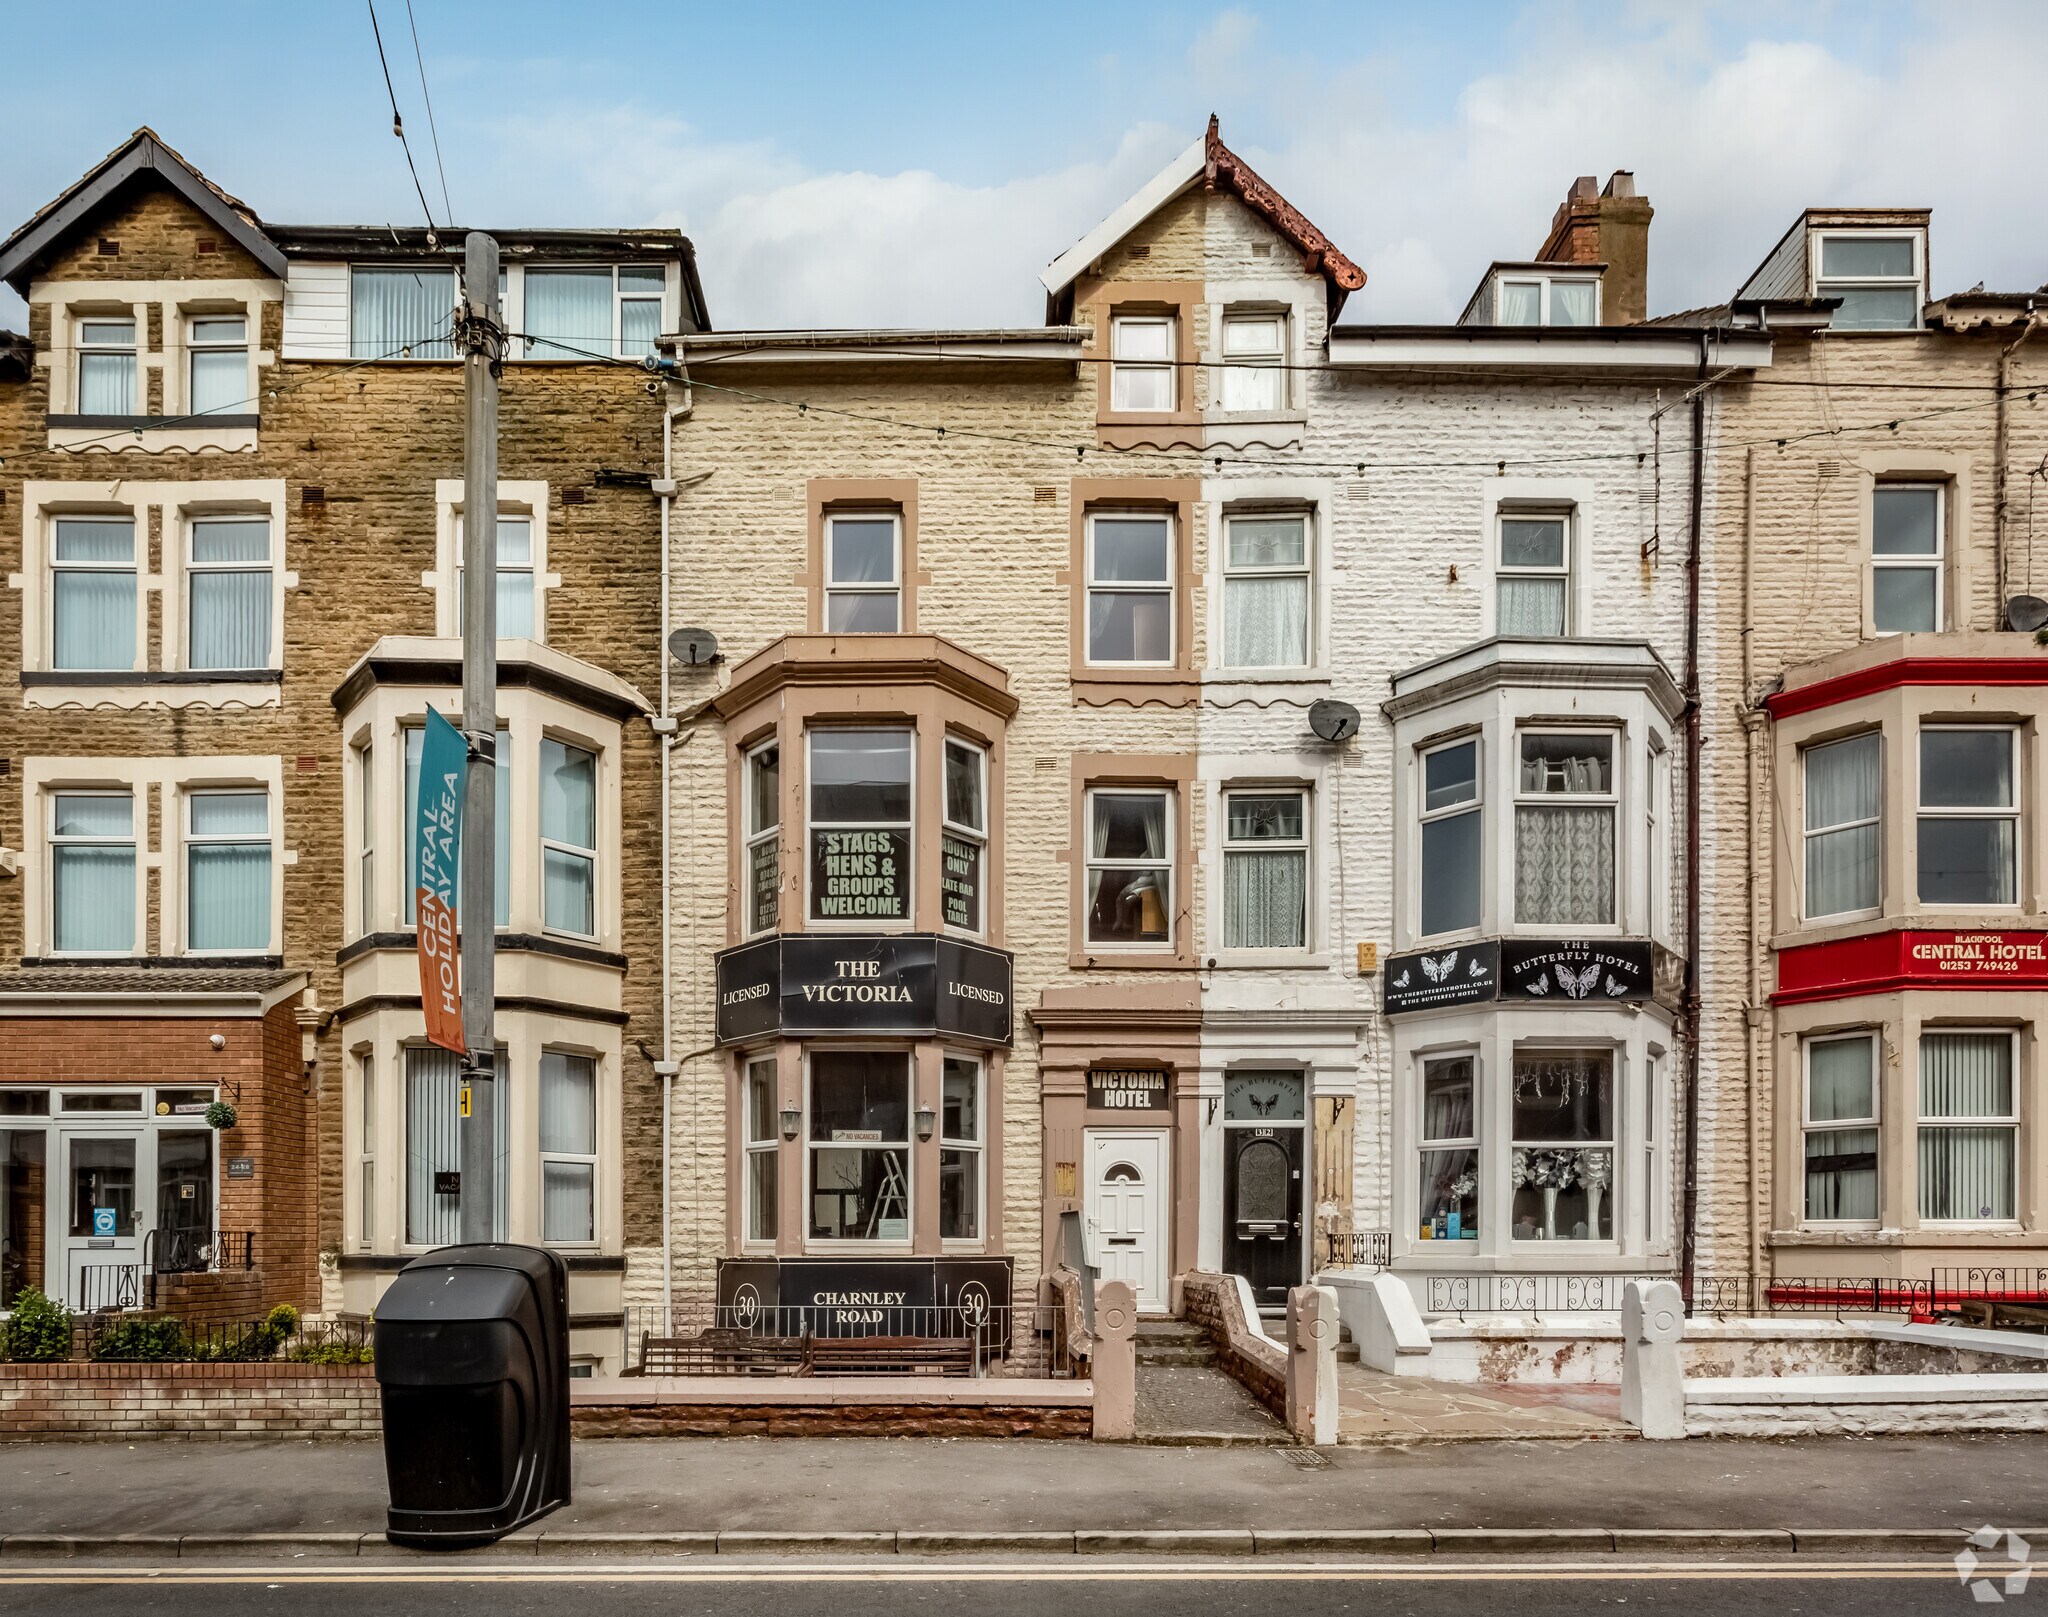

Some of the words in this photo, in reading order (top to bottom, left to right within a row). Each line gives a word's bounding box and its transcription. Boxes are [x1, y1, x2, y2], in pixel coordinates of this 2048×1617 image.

[439, 773, 458, 862] AREA
[827, 832, 895, 855] STAGS,
[942, 838, 975, 862] ADULTS
[826, 855, 877, 876] HENS
[881, 857, 896, 876] &
[947, 856, 969, 876] ONLY
[422, 807, 438, 958] CENTRAL
[827, 877, 894, 896] GROUPS
[942, 877, 958, 892] LATE
[959, 881, 974, 897] BAR
[821, 896, 901, 915] WELCOME
[948, 897, 967, 912] POOL
[947, 909, 968, 925] TABLE
[438, 868, 456, 1015] HOLIDAY
[1561, 941, 1590, 949] THE
[1955, 935, 2004, 944] BLACKPOOL
[1912, 944, 1985, 959] CENTRAL
[1990, 944, 2047, 960] HOTEL
[834, 960, 881, 978] THE
[1513, 951, 1590, 974] BUTTERFLY
[1595, 953, 1640, 975] HOTEL
[1940, 961, 1971, 971] 01253
[1976, 961, 2019, 971] 749426
[723, 983, 770, 1006] LICENSED
[802, 985, 913, 1003] VICTORIA
[949, 981, 1004, 1005] LICENSED
[1387, 979, 1493, 1001] WWW.THEBUTTERFLYHOTEL.CO.UK
[1421, 993, 1456, 1003] BUTTERFLY
[1457, 989, 1479, 997] HOTEL
[1091, 1071, 1165, 1090] VICTORIA
[1230, 1084, 1245, 1097] THE
[1248, 1077, 1297, 1097] BUTTERFLY
[1104, 1090, 1152, 1108] HOTEL
[739, 1295, 755, 1317] 30
[813, 1292, 906, 1306] CHARNLEY
[964, 1293, 984, 1315] 30
[835, 1310, 884, 1323] ROAD
